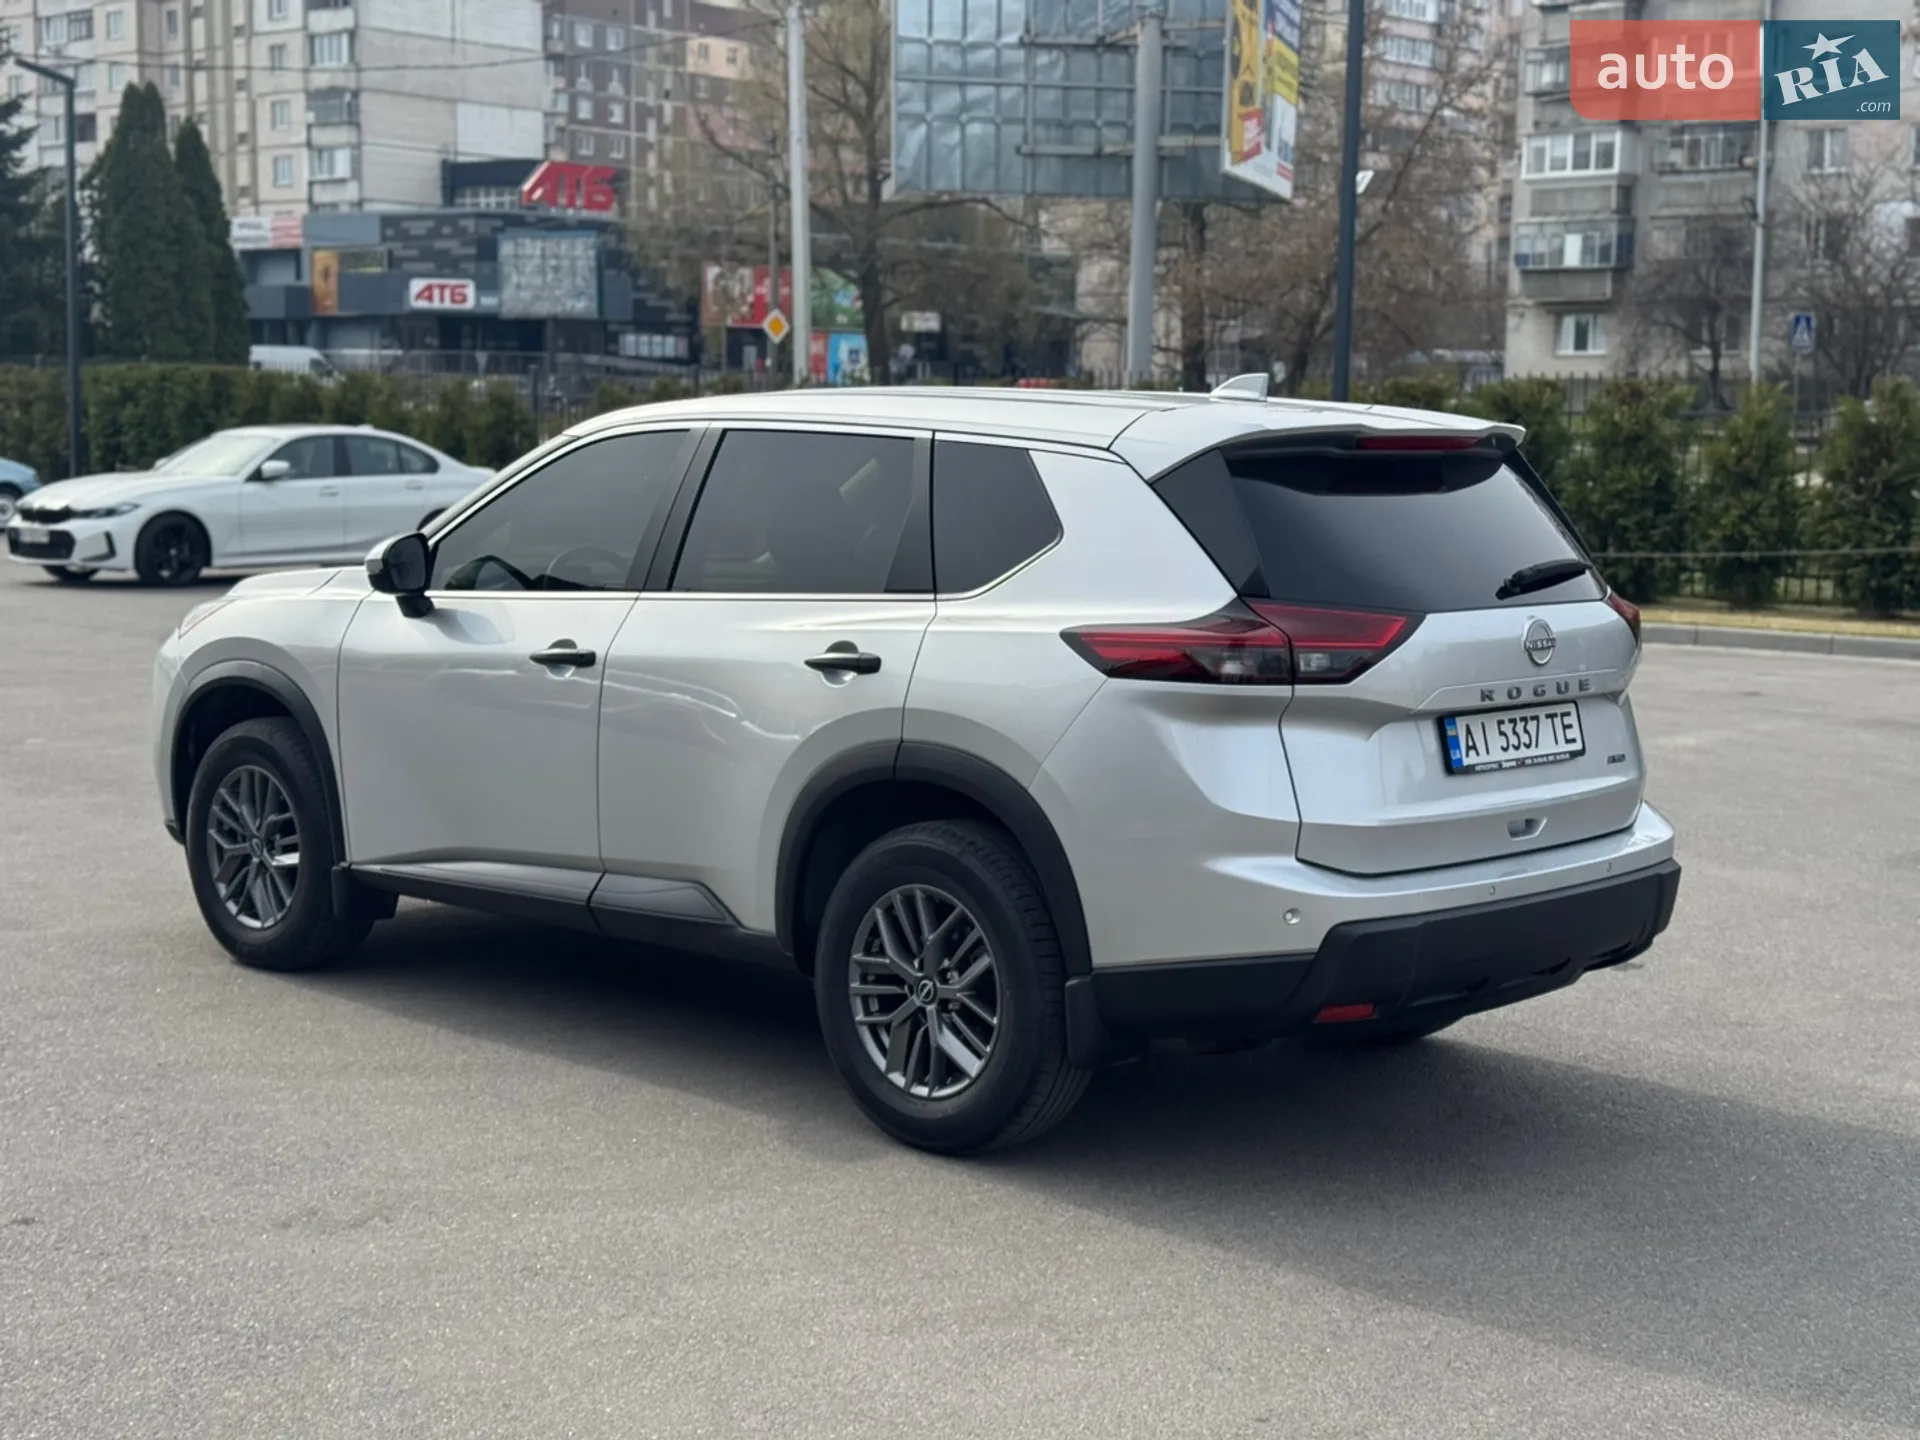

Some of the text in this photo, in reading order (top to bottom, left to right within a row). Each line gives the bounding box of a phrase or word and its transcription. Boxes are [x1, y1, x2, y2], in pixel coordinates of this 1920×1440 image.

[521, 160, 617, 212] АТБ
[414, 283, 469, 305] АТБ
[1480, 678, 1592, 702] ROGUE
[1464, 711, 1577, 758] AI 5337 TE
